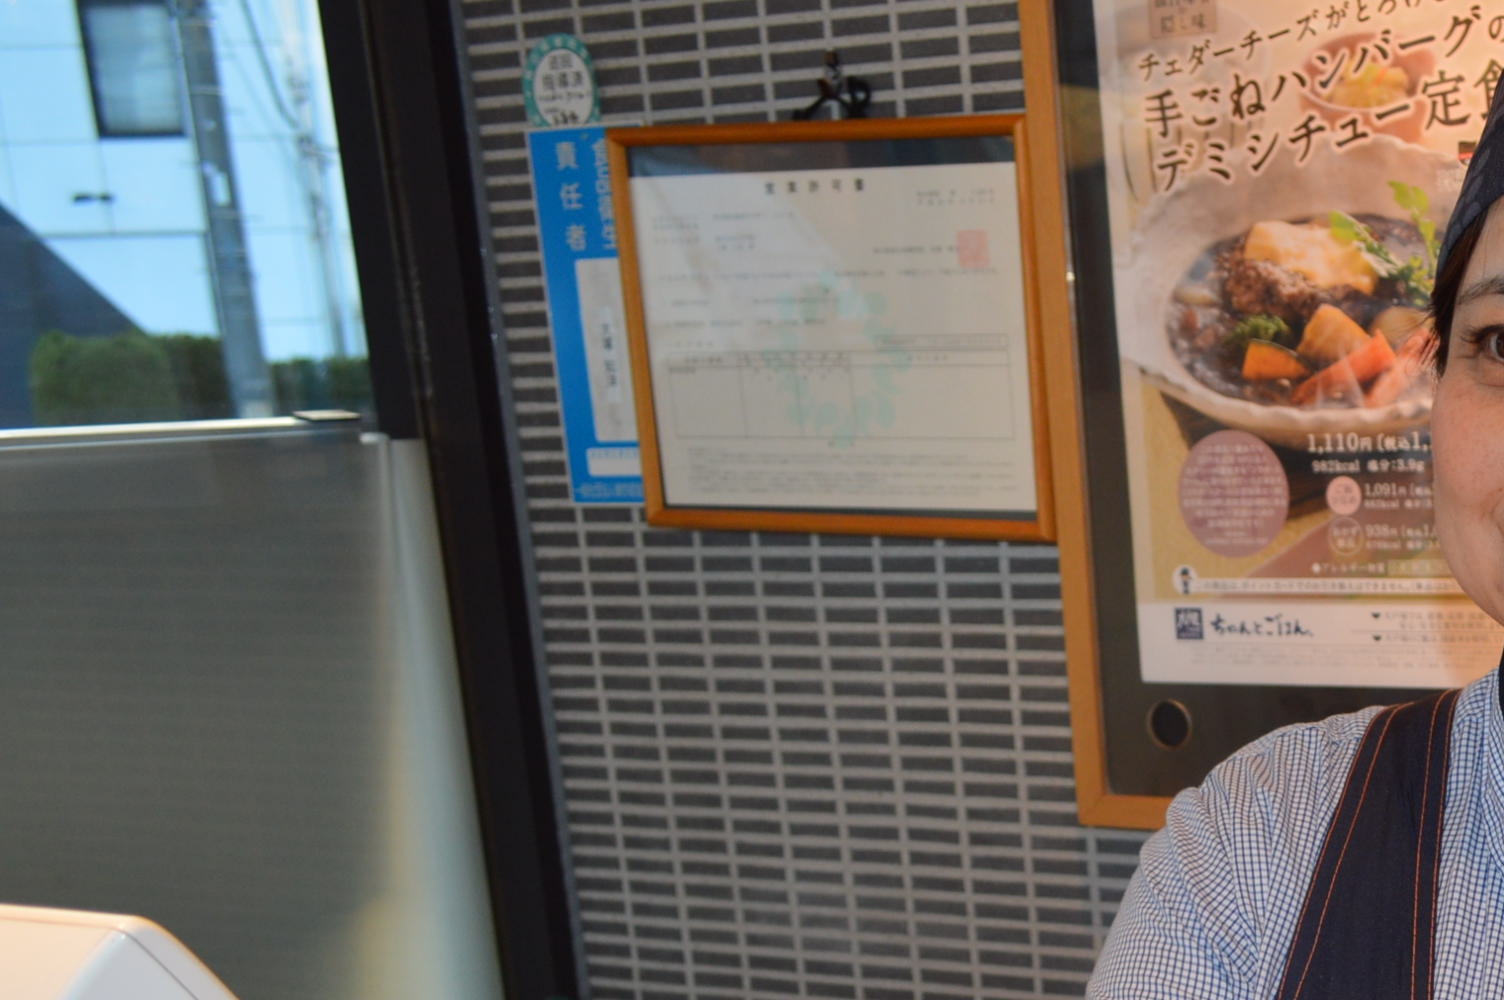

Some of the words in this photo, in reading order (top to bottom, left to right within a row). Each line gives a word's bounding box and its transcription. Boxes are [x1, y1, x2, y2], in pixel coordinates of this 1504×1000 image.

[1138, 0, 1452, 82] チェダーチーズがとろ
